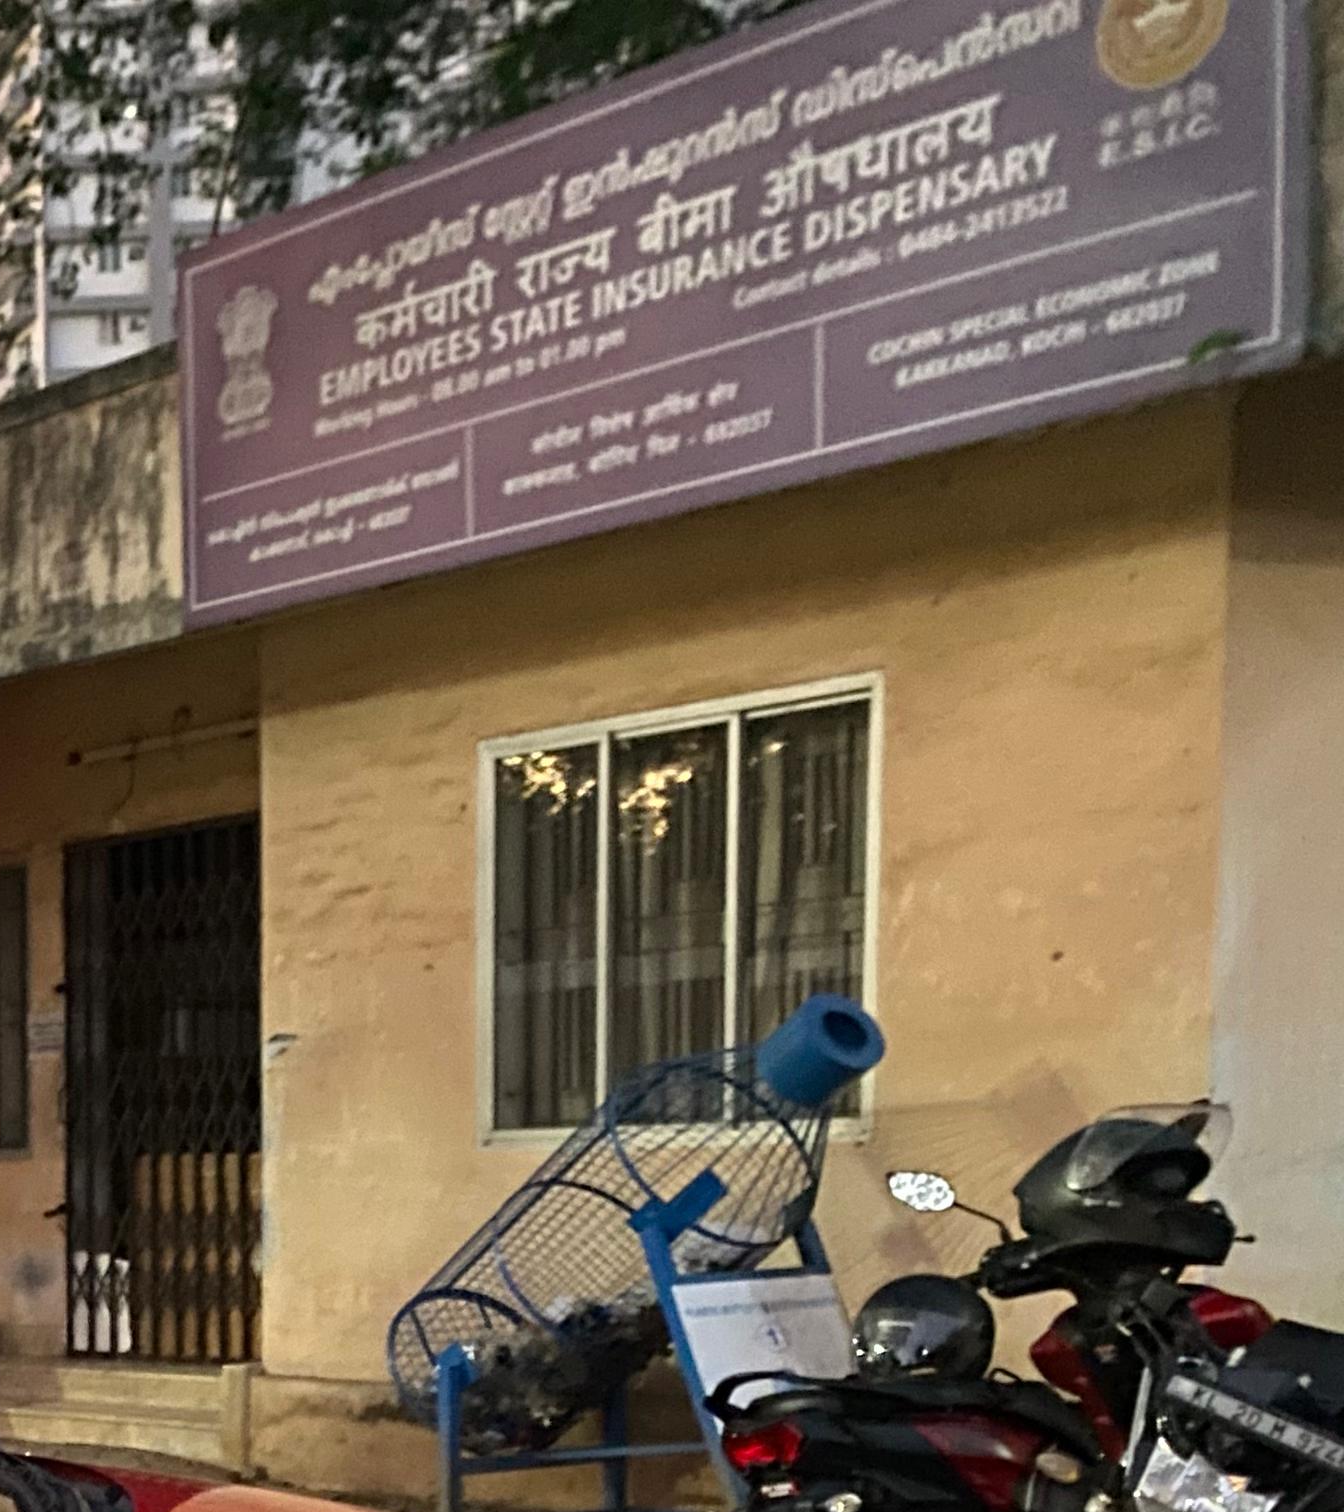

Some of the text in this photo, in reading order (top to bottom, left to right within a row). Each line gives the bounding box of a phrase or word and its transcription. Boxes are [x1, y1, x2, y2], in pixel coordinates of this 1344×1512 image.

[319, 134, 1057, 406] EMPLOYEES STATE INSURANCE DISPENSARY
[356, 94, 1002, 349] कर्मचारी राज्य बीमा औषधालय
